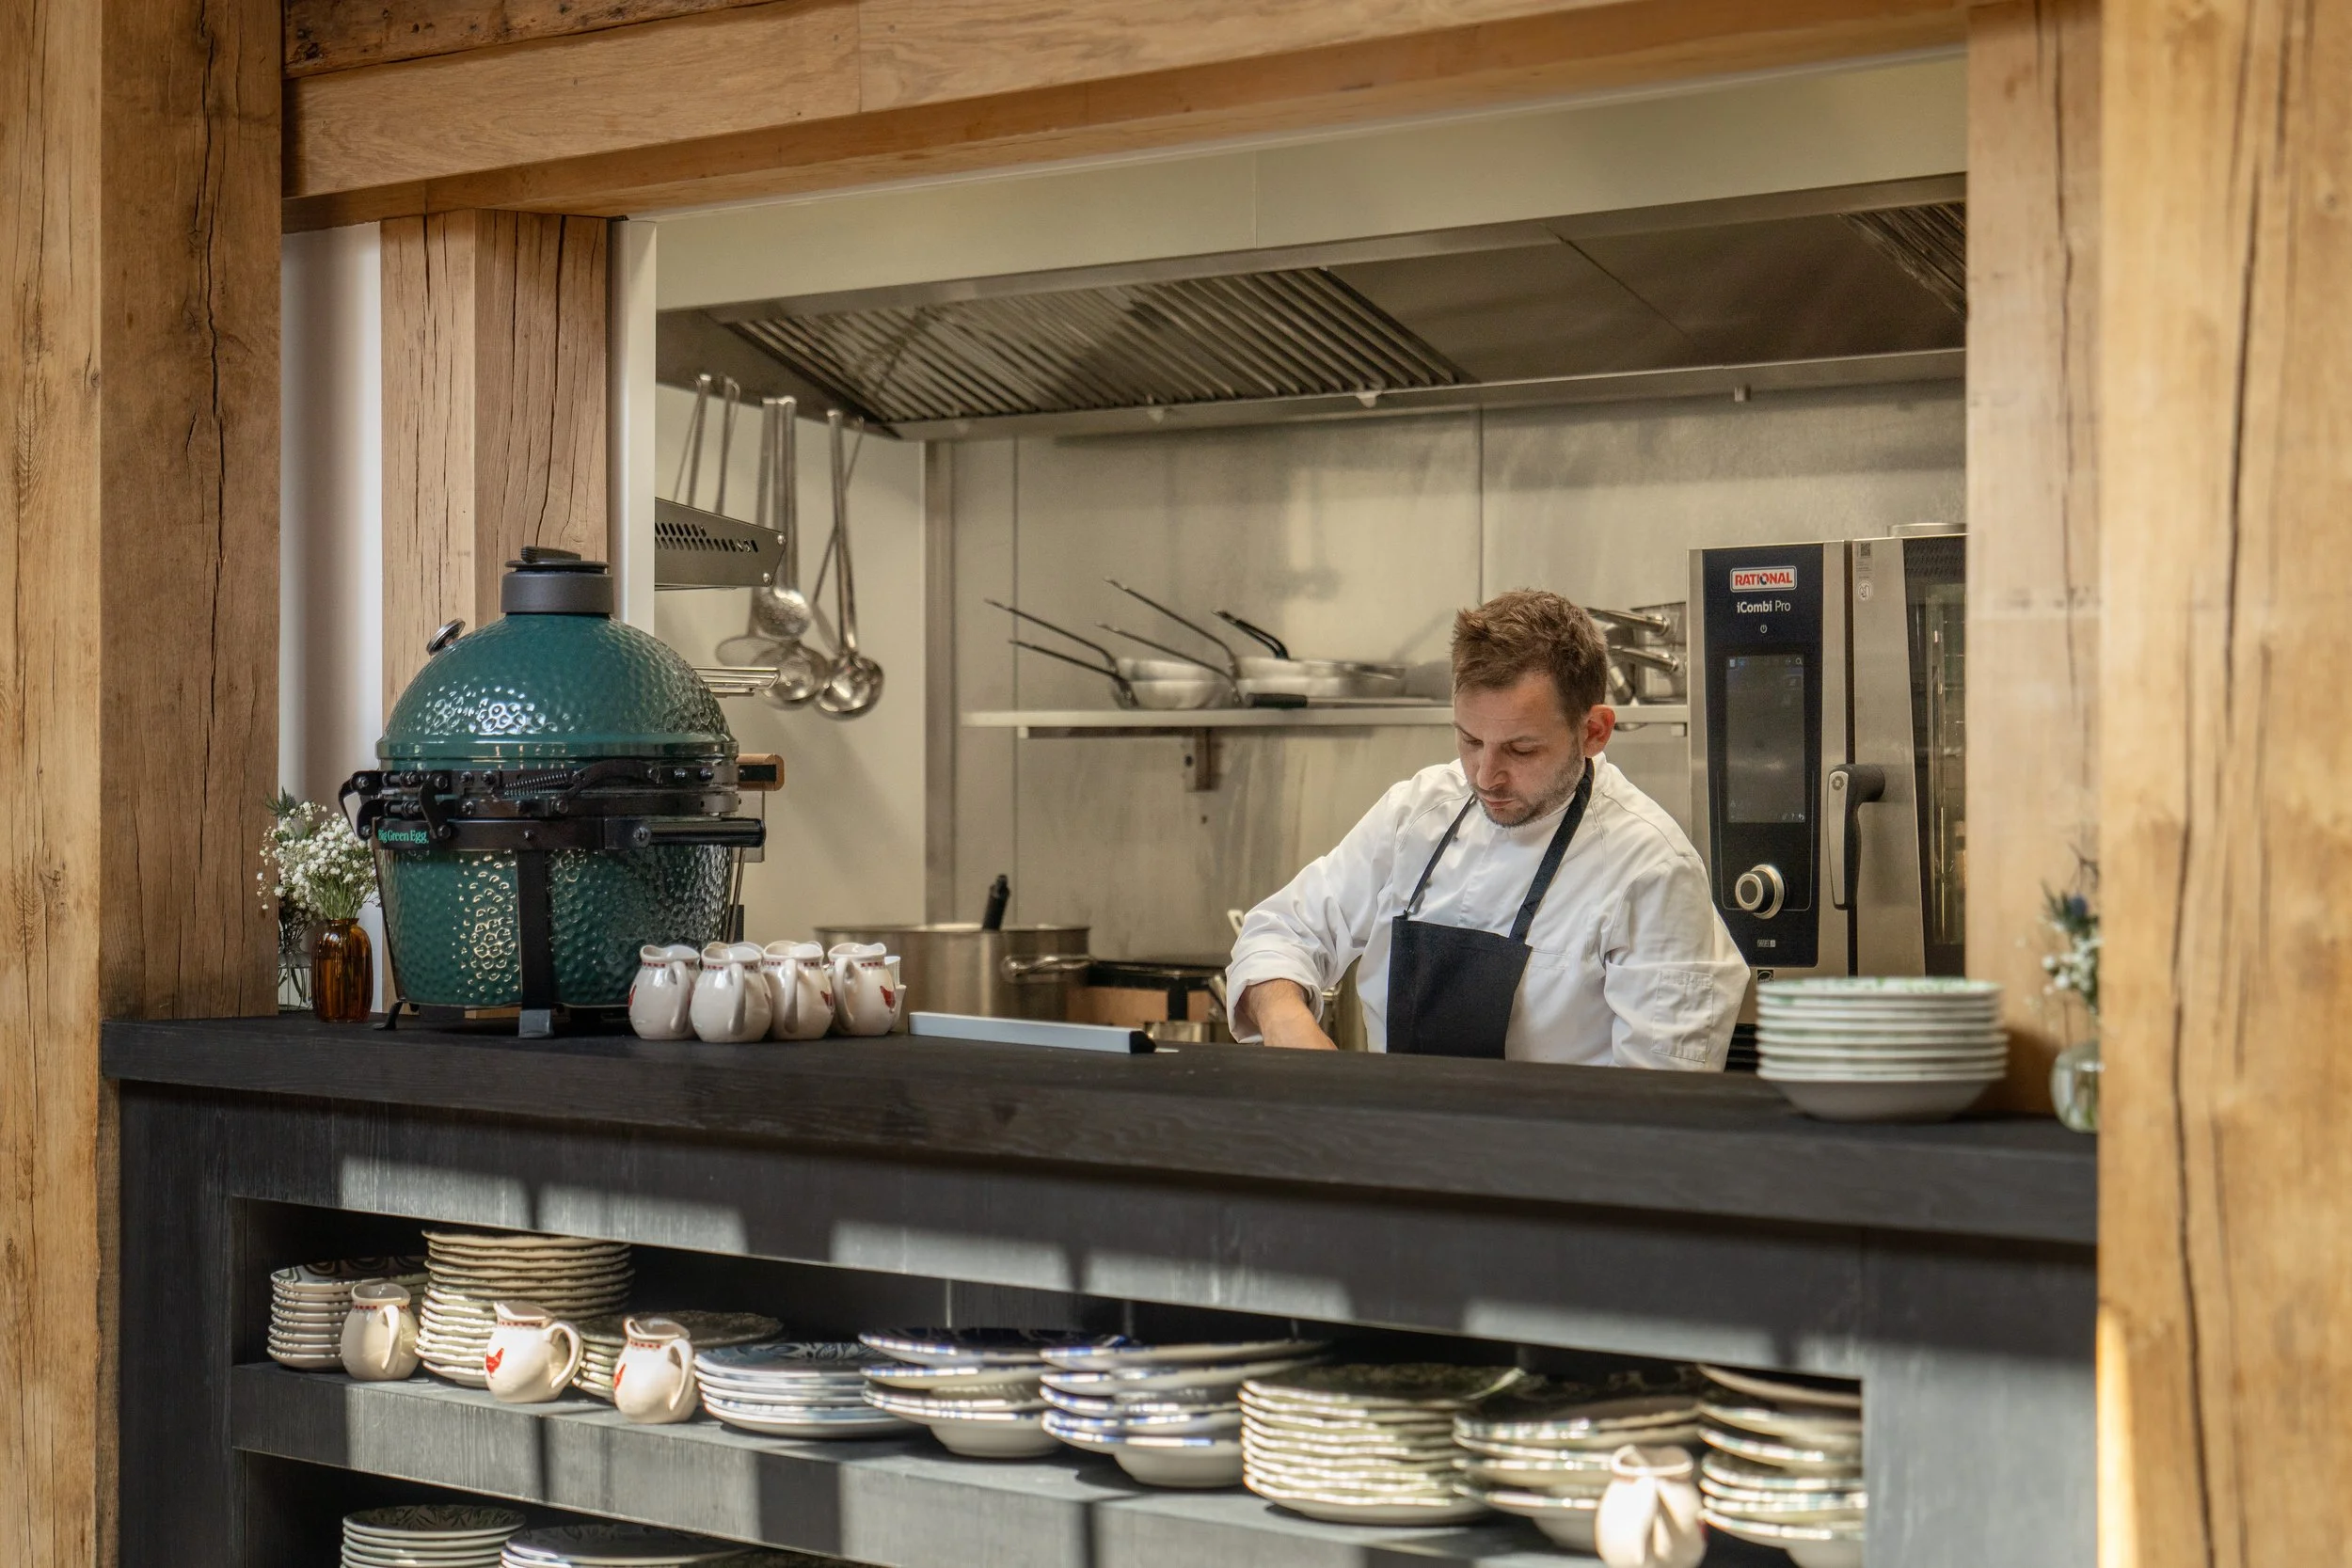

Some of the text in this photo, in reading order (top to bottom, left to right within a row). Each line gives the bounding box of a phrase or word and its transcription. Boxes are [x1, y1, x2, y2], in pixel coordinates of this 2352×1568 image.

[1735, 571, 1792, 586] RATIONAL
[1737, 599, 1791, 613] iCombi Pro
[377, 829, 427, 845] Big Green Egg
